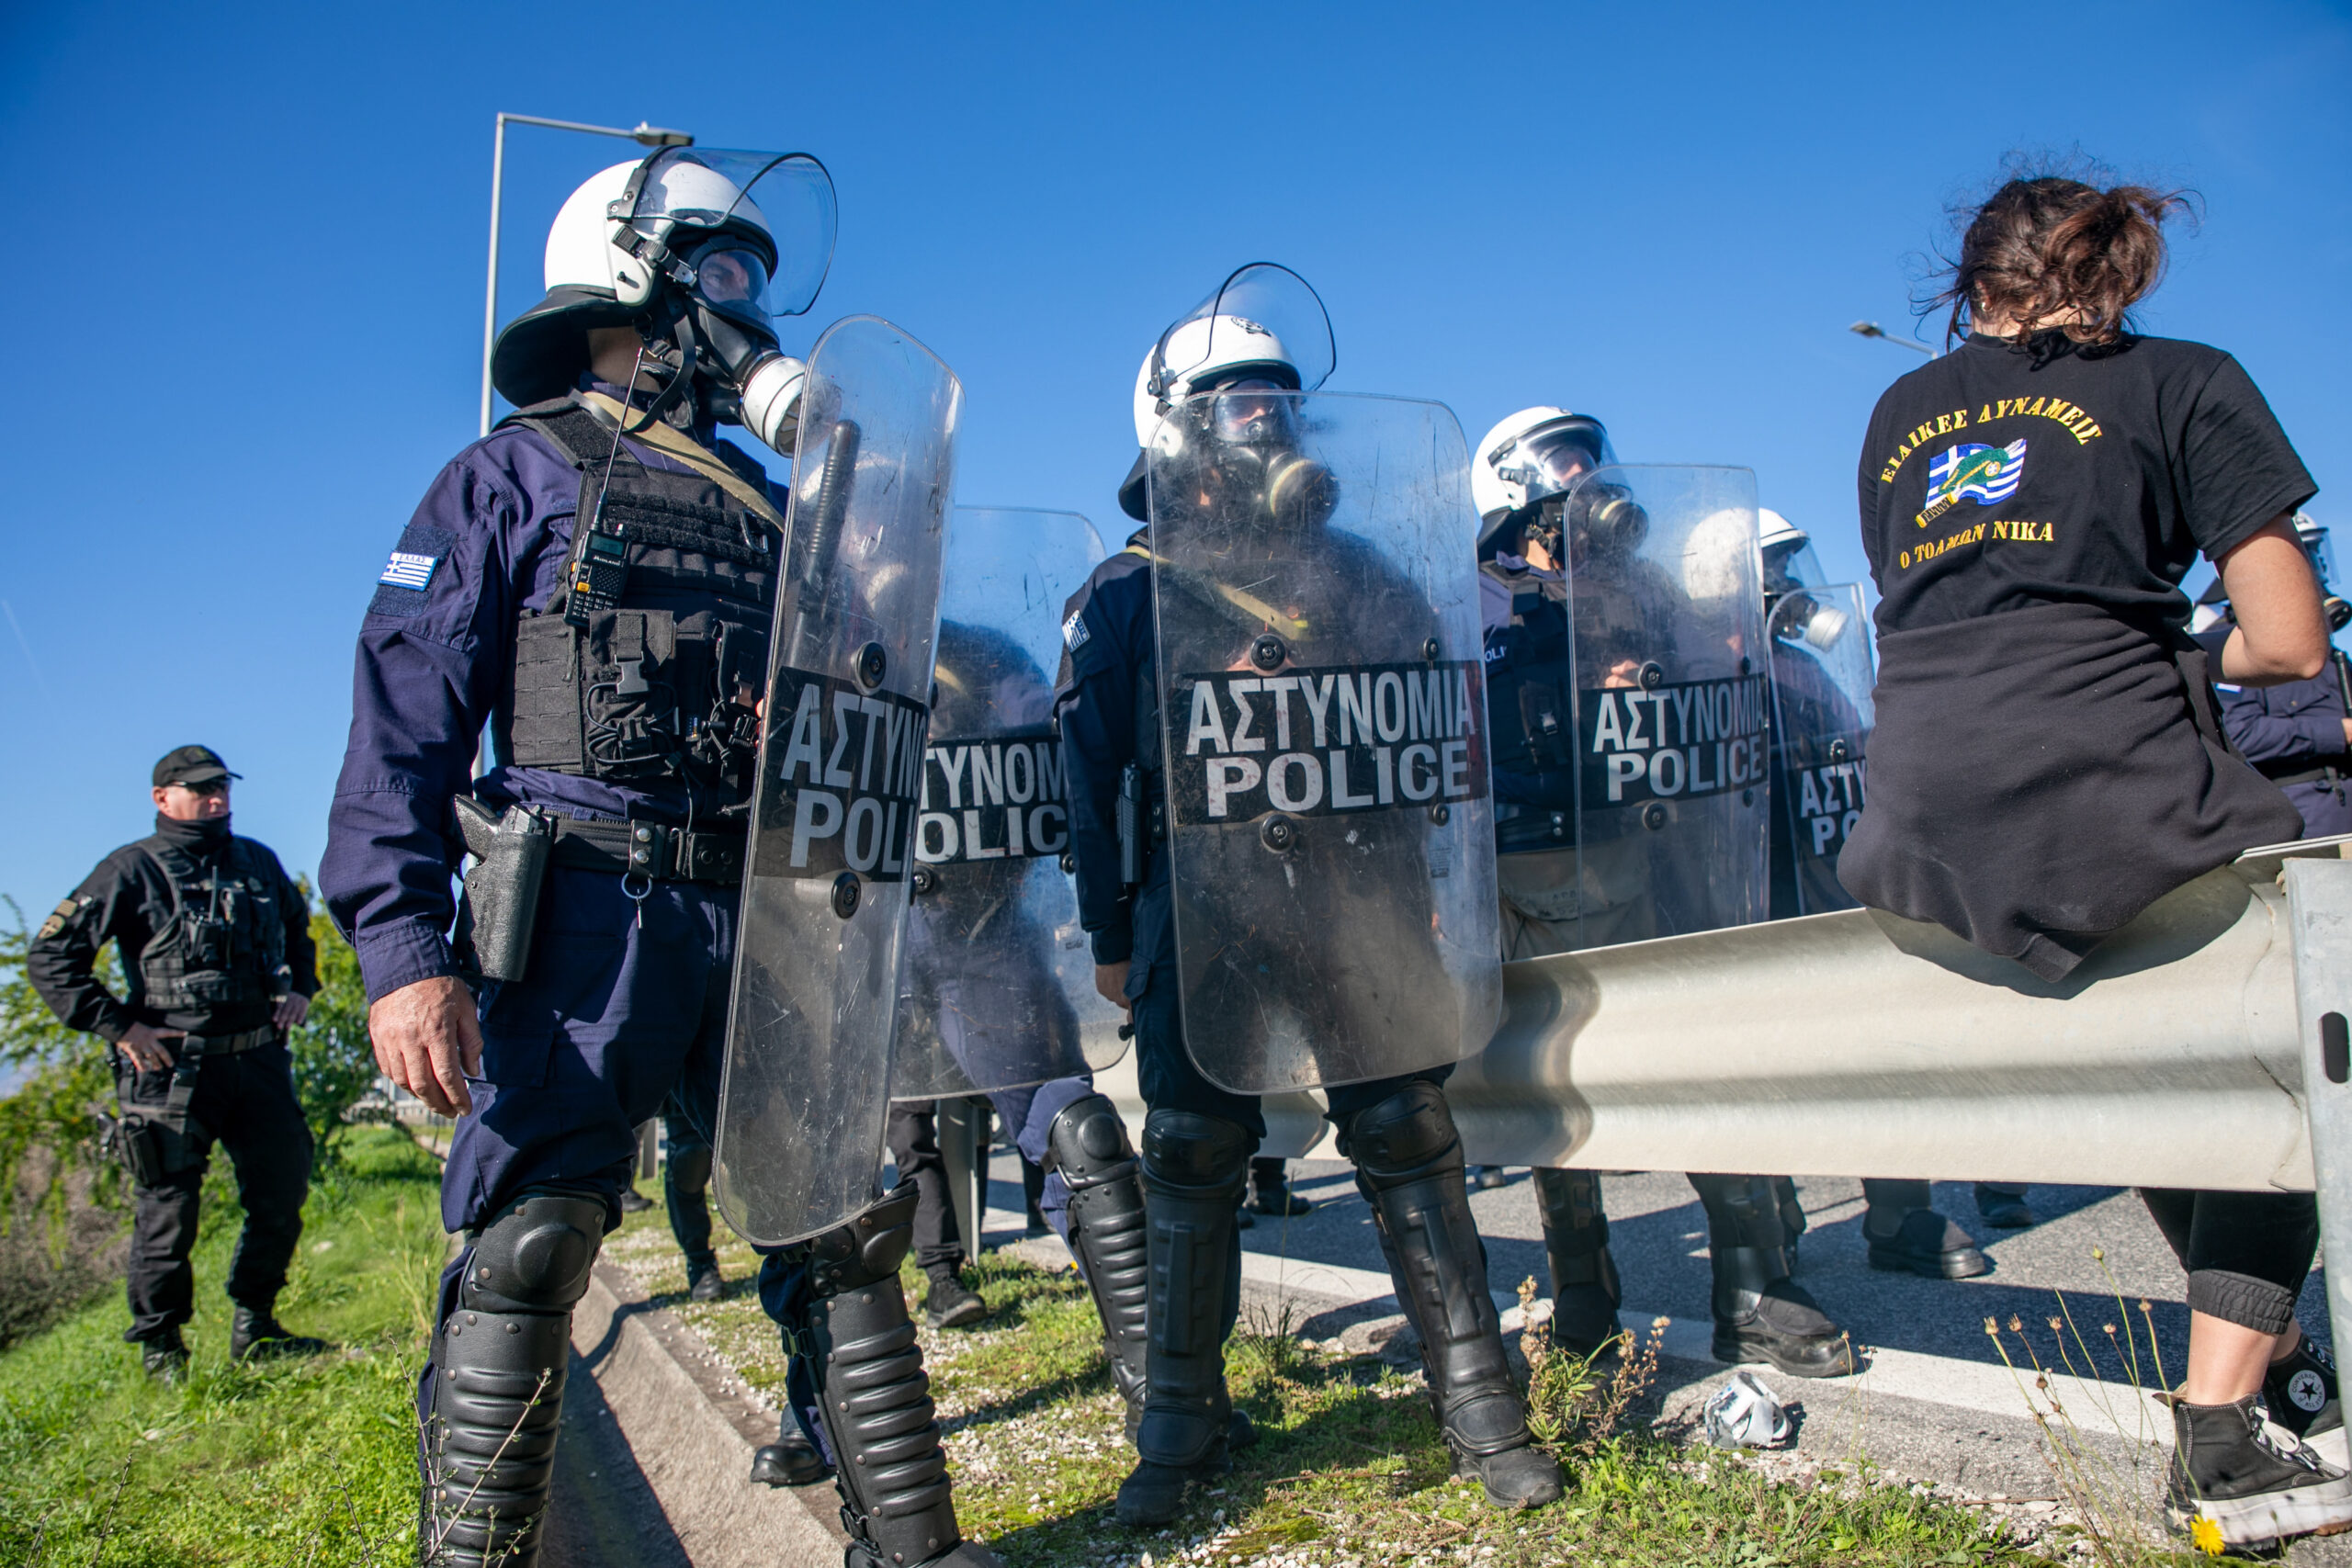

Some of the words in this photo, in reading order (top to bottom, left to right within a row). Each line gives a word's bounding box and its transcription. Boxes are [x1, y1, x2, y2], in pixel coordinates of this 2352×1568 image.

[1976, 396, 2103, 446] ΔΥΝΑΜΕΙΣ
[1899, 551, 1910, 569] Ο
[1914, 523, 1986, 563] ΤΟΛΜΩΝ
[1992, 521, 2053, 542] ΝΙΚΑ
[1484, 646, 1507, 662] OLI
[780, 682, 927, 800] ΑΣΤΥΝΟ
[1185, 668, 1476, 755] ΑΣΤΥΝΟΜΙΑ
[1592, 678, 1764, 753] ΑΣΤΥΝΟΜΙΑ
[921, 741, 1069, 810] ΤΥΝΟΜ
[1205, 740, 1470, 818] POLICE
[1606, 734, 1762, 802] POLICE
[789, 788, 915, 874] POLI
[914, 804, 1068, 863] OLIC
